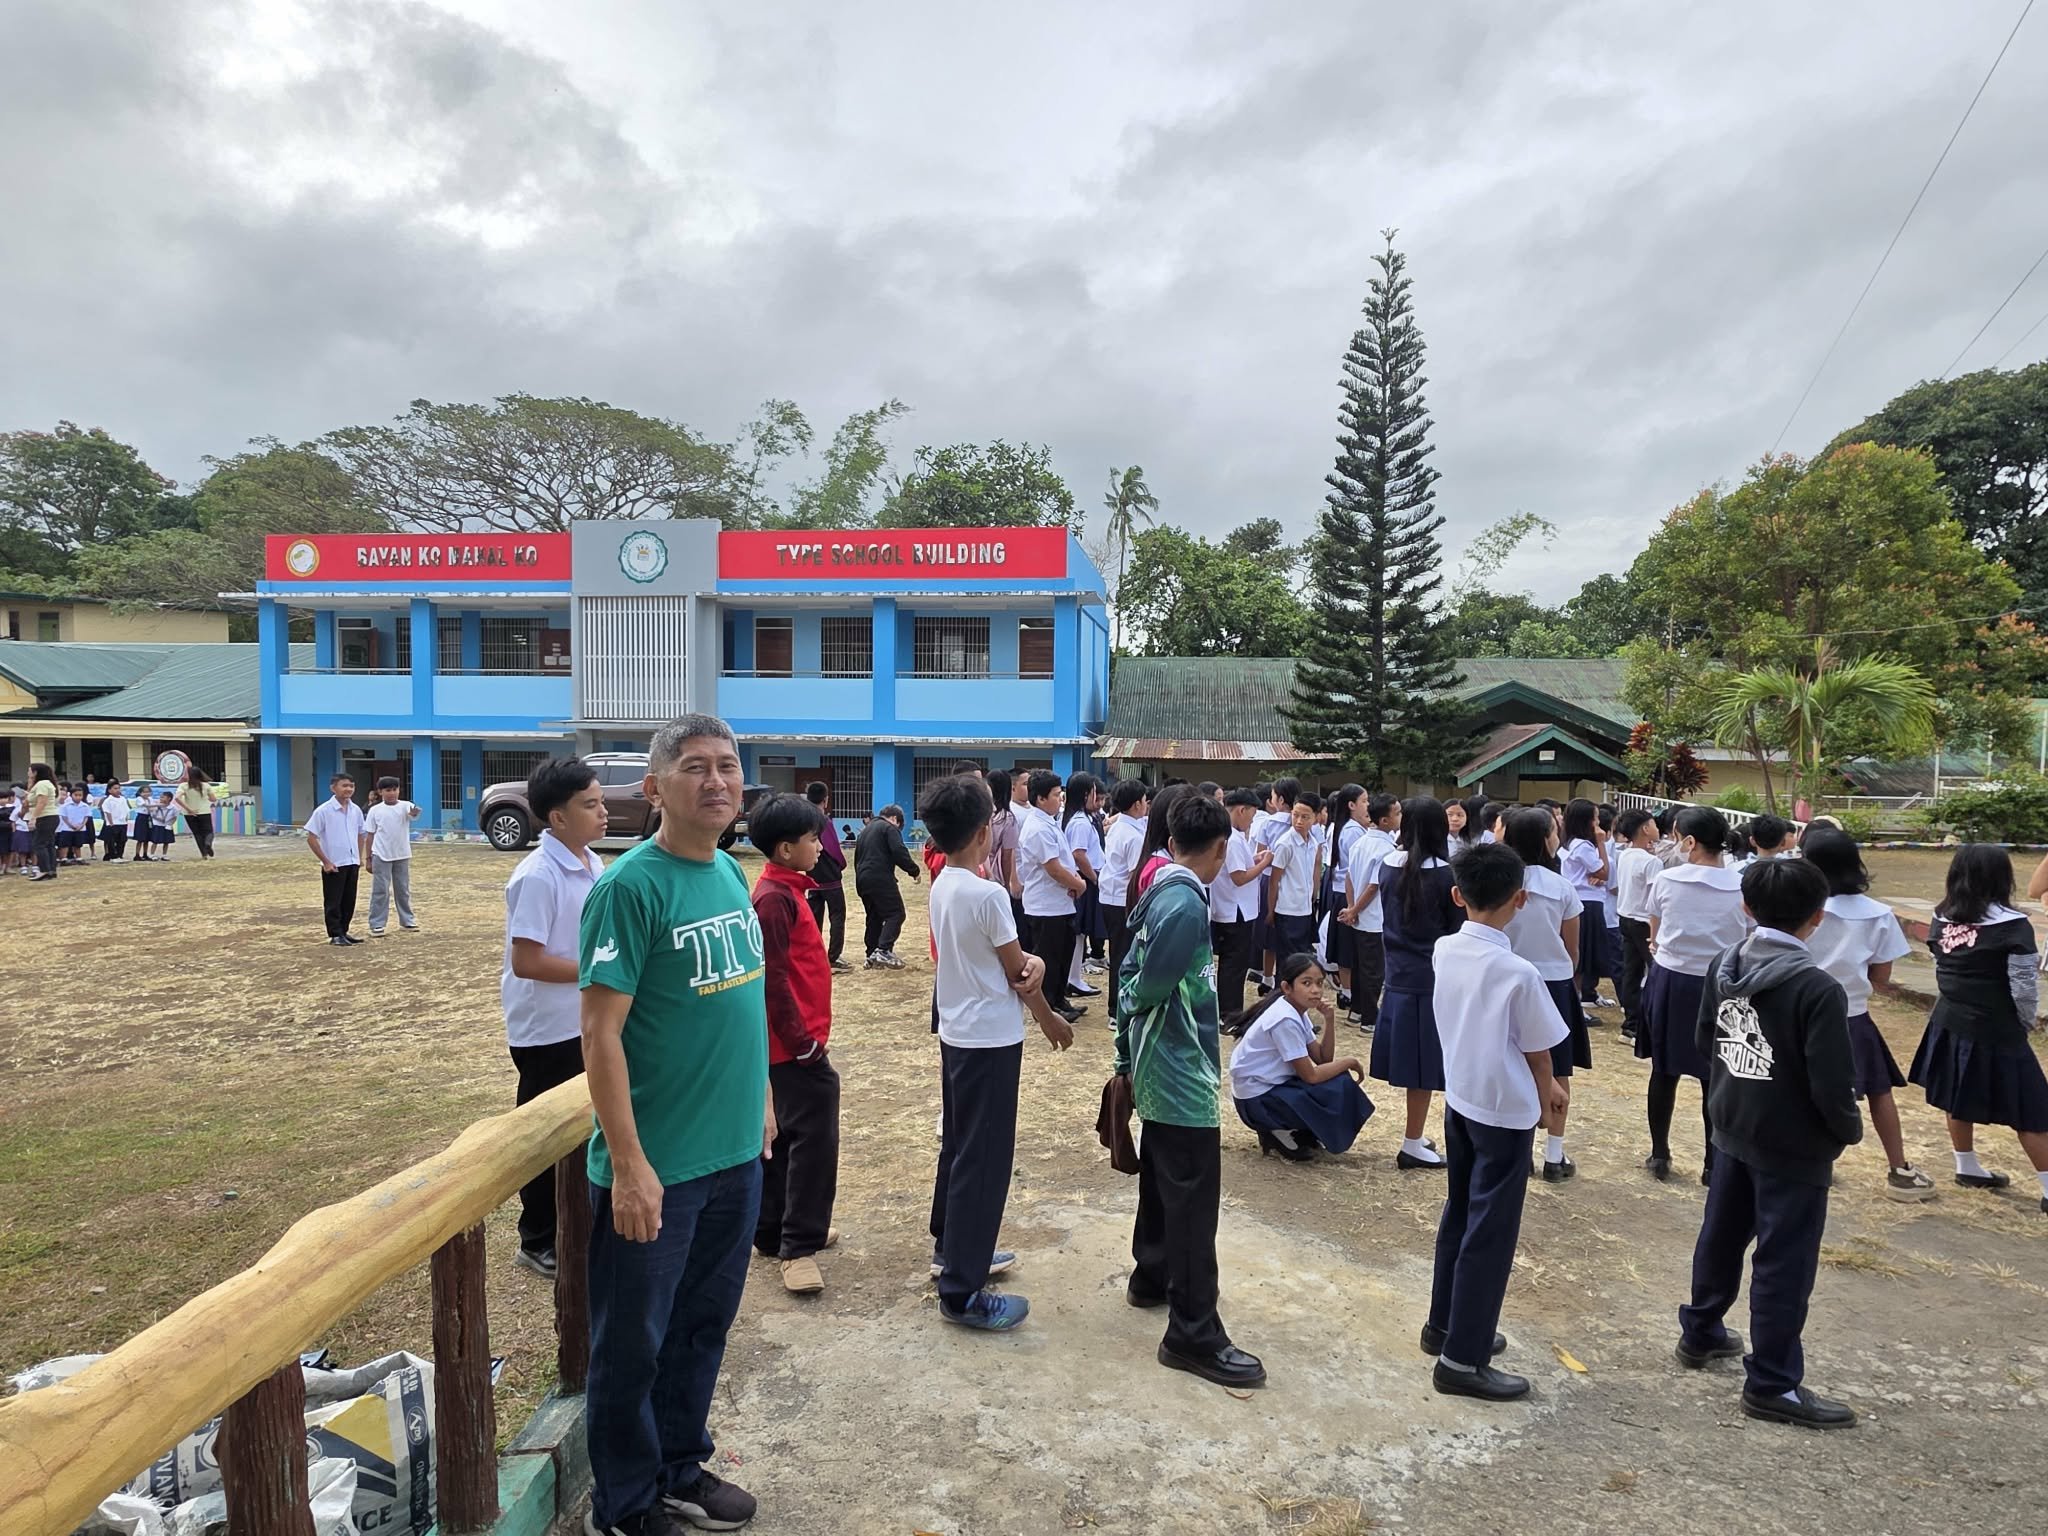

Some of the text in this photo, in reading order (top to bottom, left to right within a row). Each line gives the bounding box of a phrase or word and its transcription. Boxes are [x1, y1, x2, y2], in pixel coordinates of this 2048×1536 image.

[356, 546, 412, 567] BAYAN
[418, 546, 441, 567] KO
[514, 544, 538, 567] KO
[775, 542, 1006, 566] TYPE SCHOOL BUILDING
[698, 984, 717, 997] FAR
[1720, 1042, 1772, 1078] DROIDS
